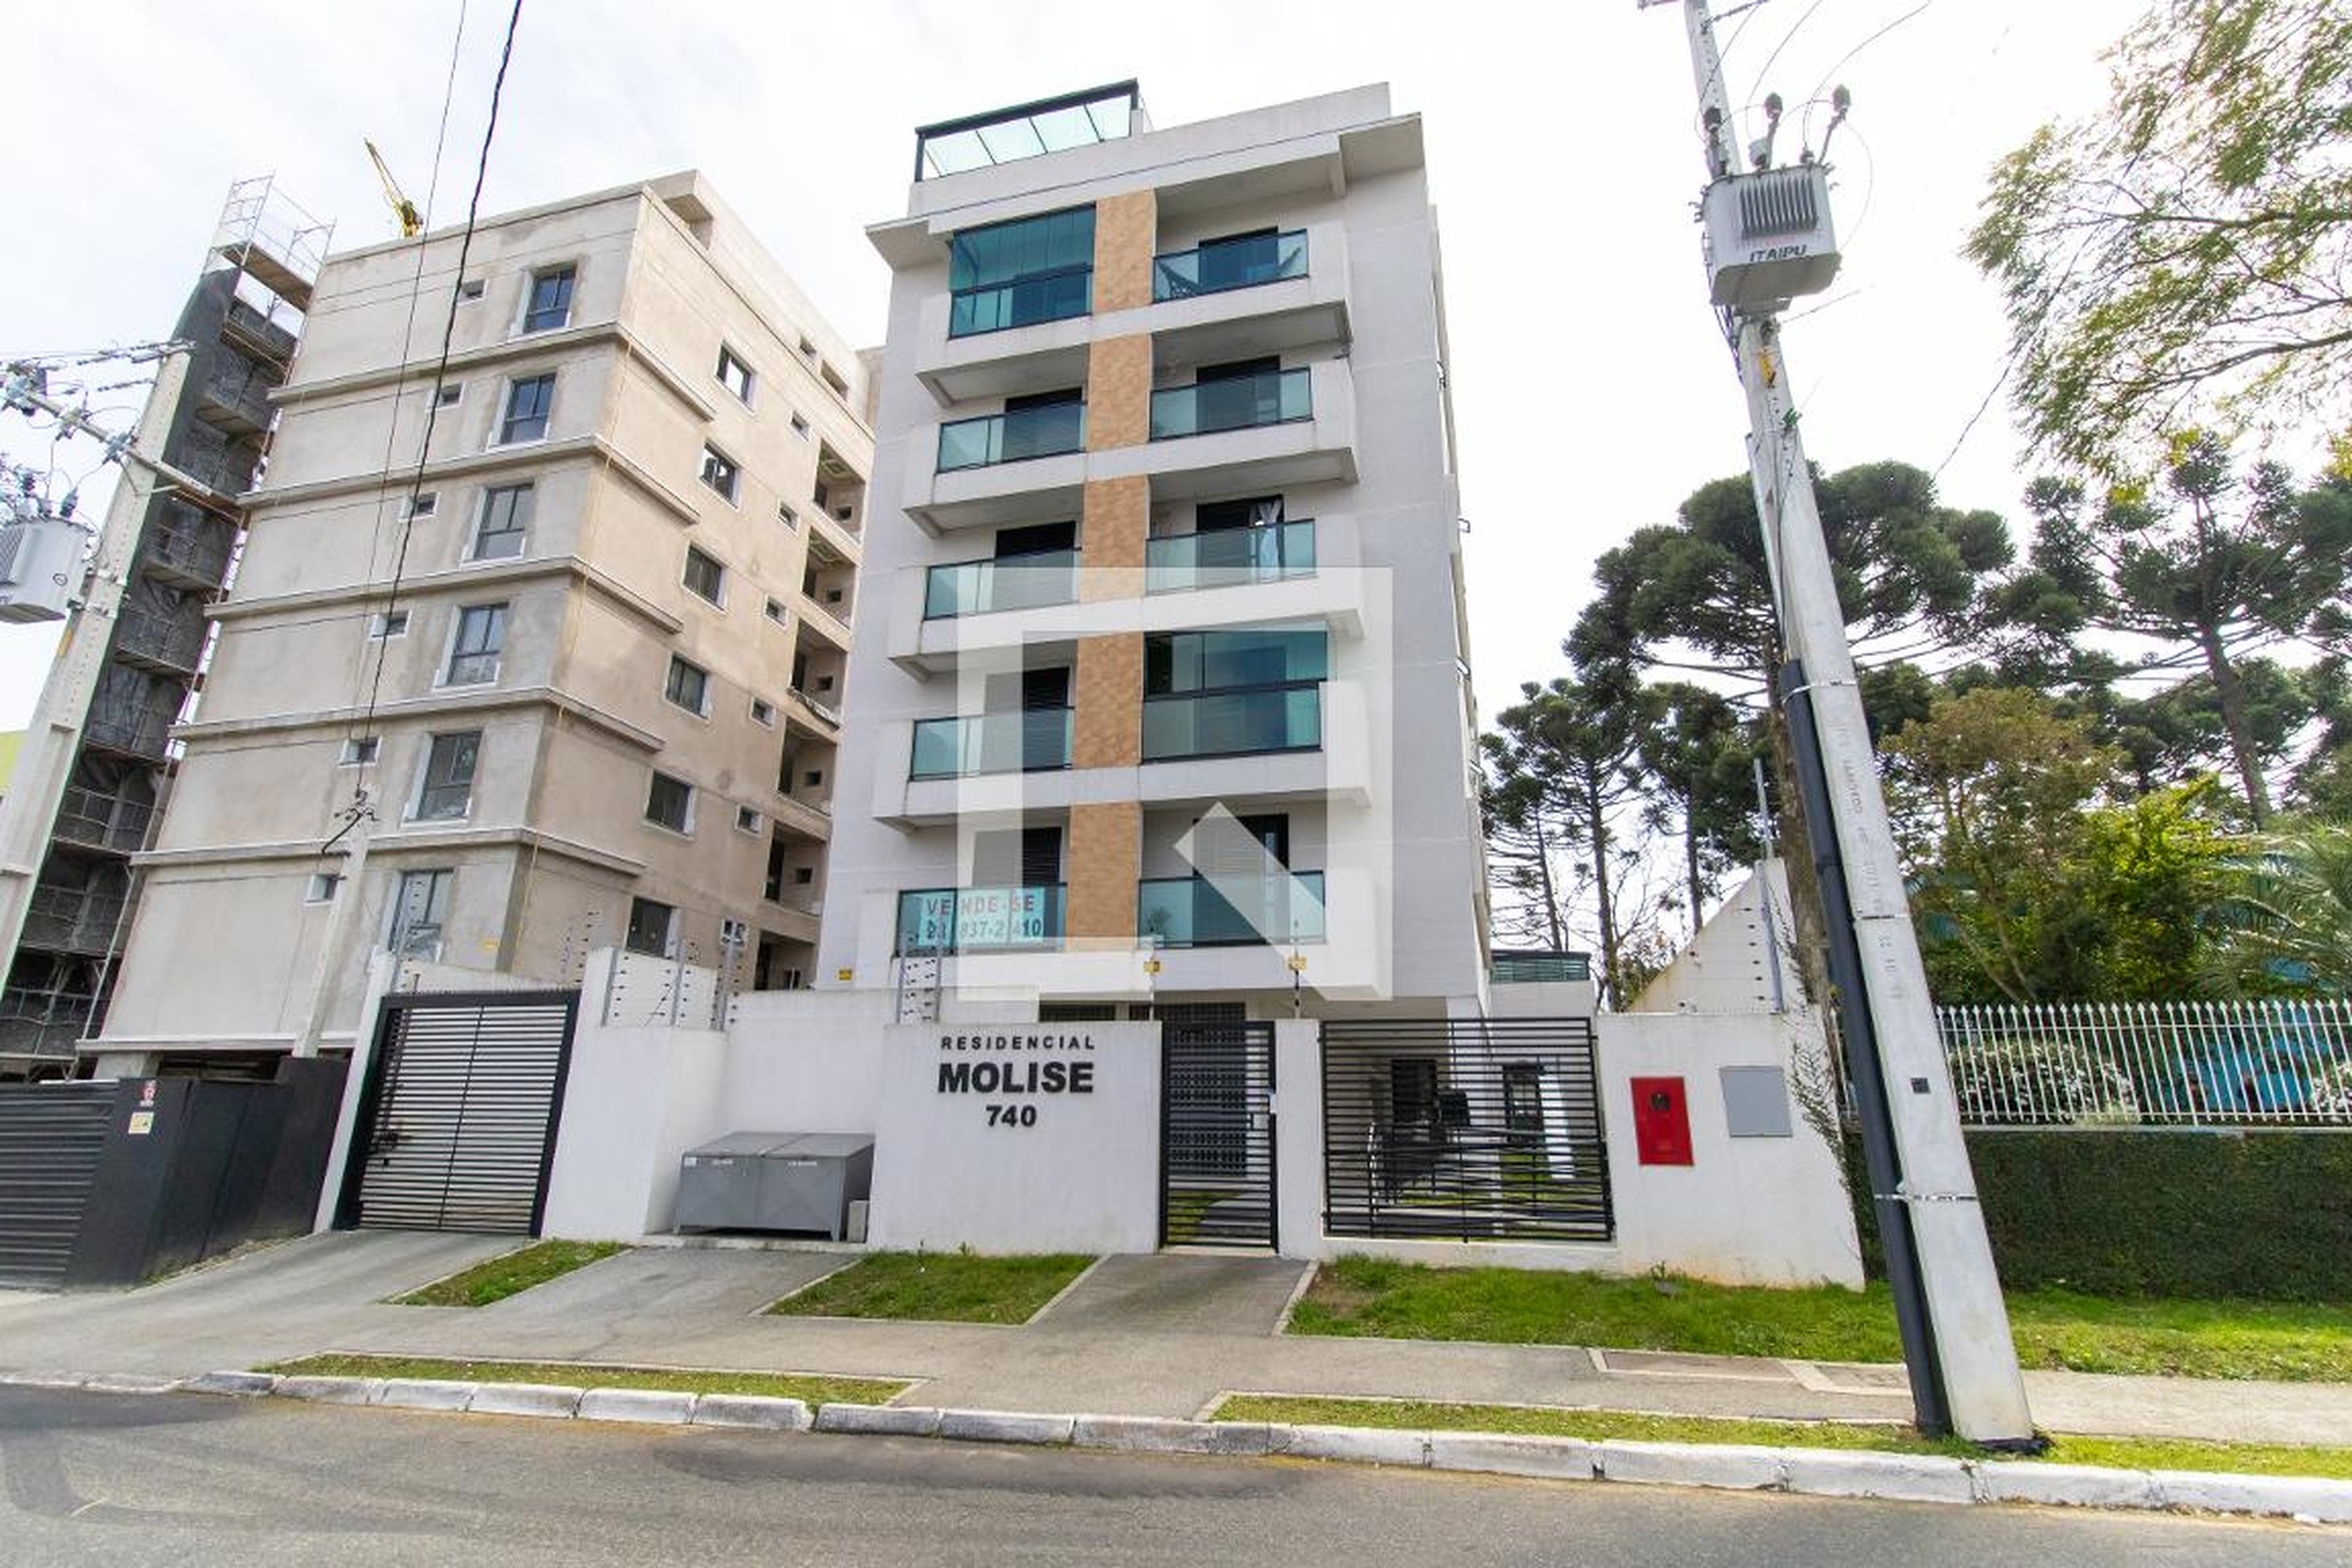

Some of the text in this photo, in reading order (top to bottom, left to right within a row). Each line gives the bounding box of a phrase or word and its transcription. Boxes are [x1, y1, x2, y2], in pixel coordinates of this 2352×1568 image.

[1750, 244, 1807, 262] ITAIPU
[941, 1035, 1095, 1050] RESIDENCIAL
[938, 1061, 1094, 1093] MOLISE
[986, 1104, 1037, 1127] 740
